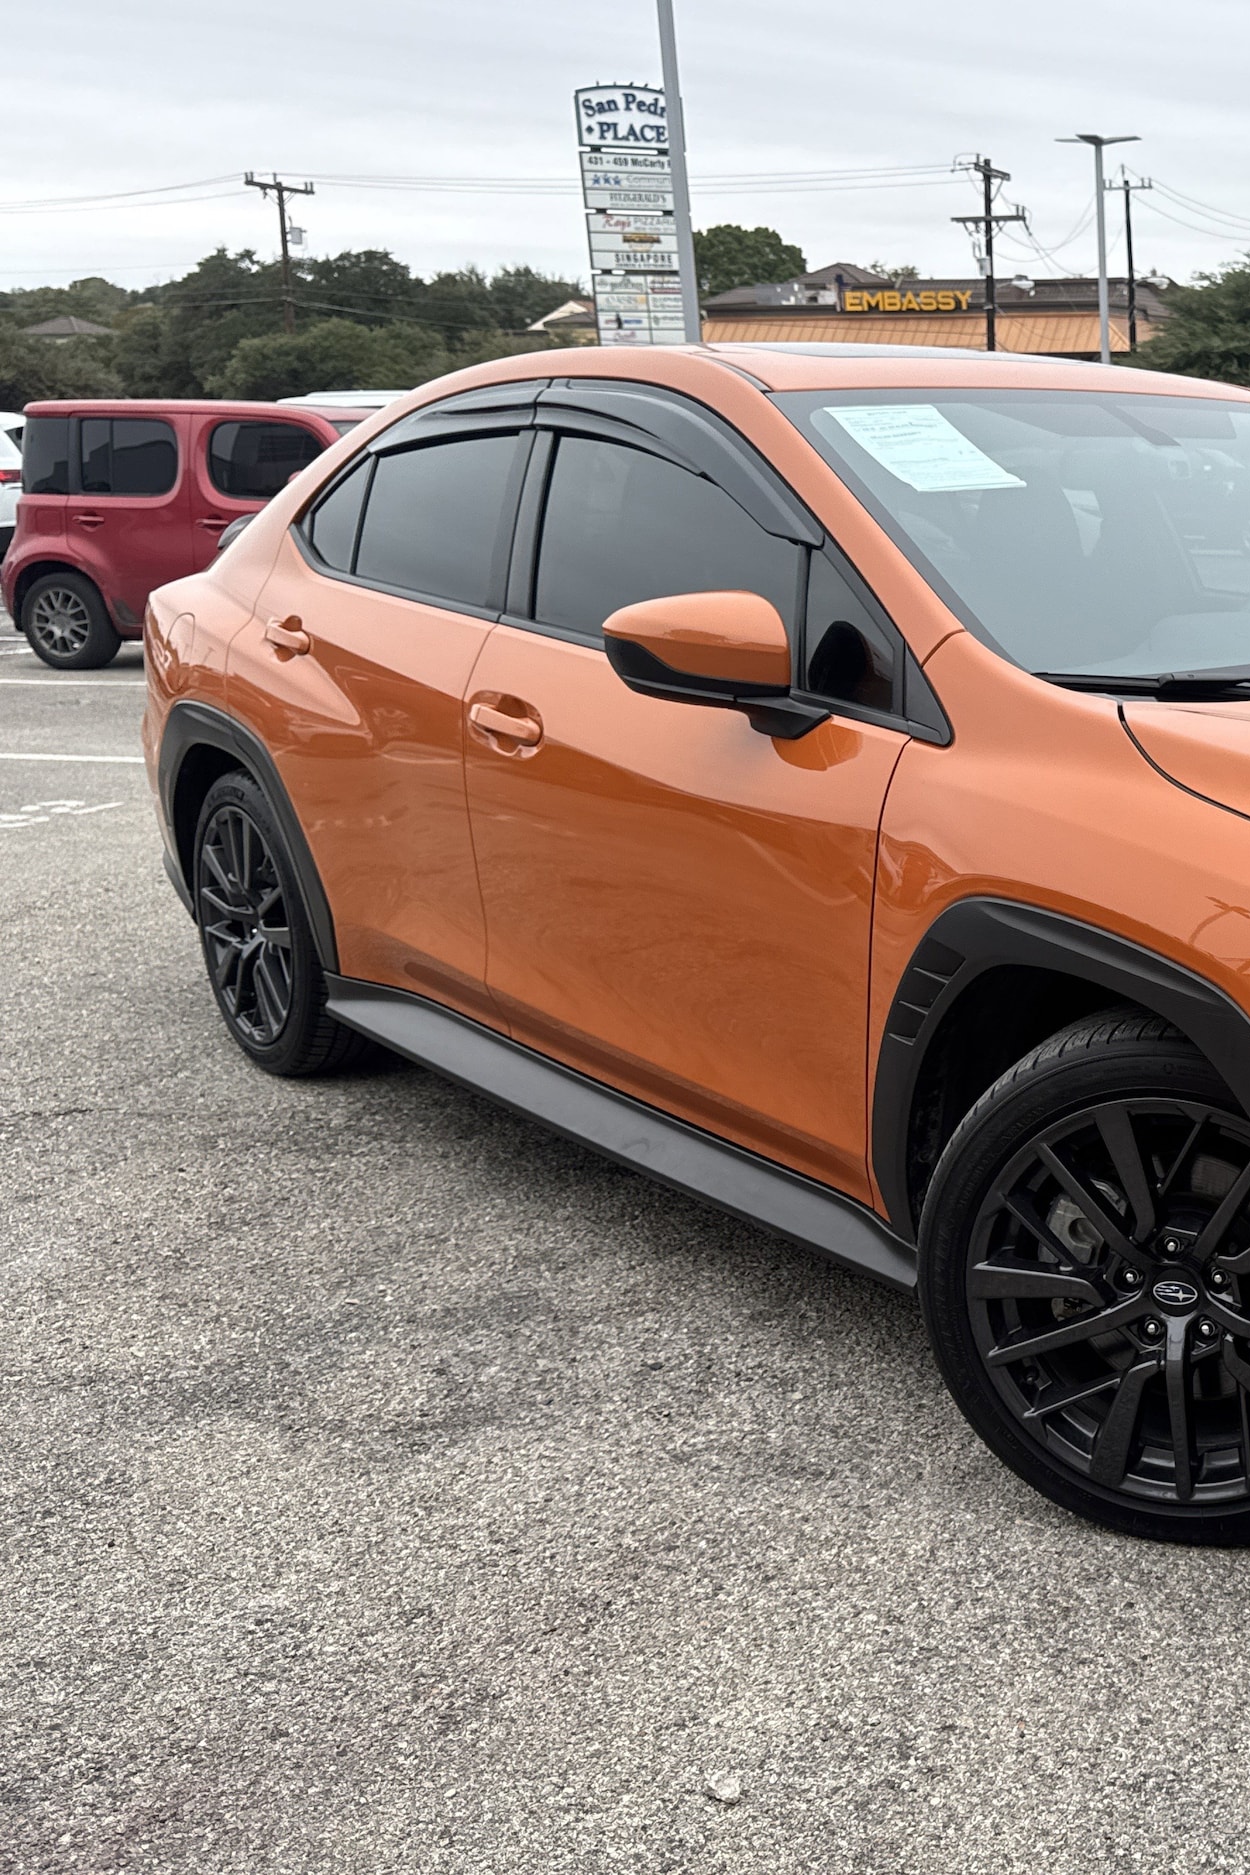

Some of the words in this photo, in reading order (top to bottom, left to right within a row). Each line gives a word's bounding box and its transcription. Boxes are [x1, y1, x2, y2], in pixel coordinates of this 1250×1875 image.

[582, 99, 620, 117] San
[622, 93, 667, 118] Pedr
[597, 122, 668, 143] PLACE
[615, 253, 672, 264] SINGAPORE
[844, 289, 973, 312] EMBASSY
